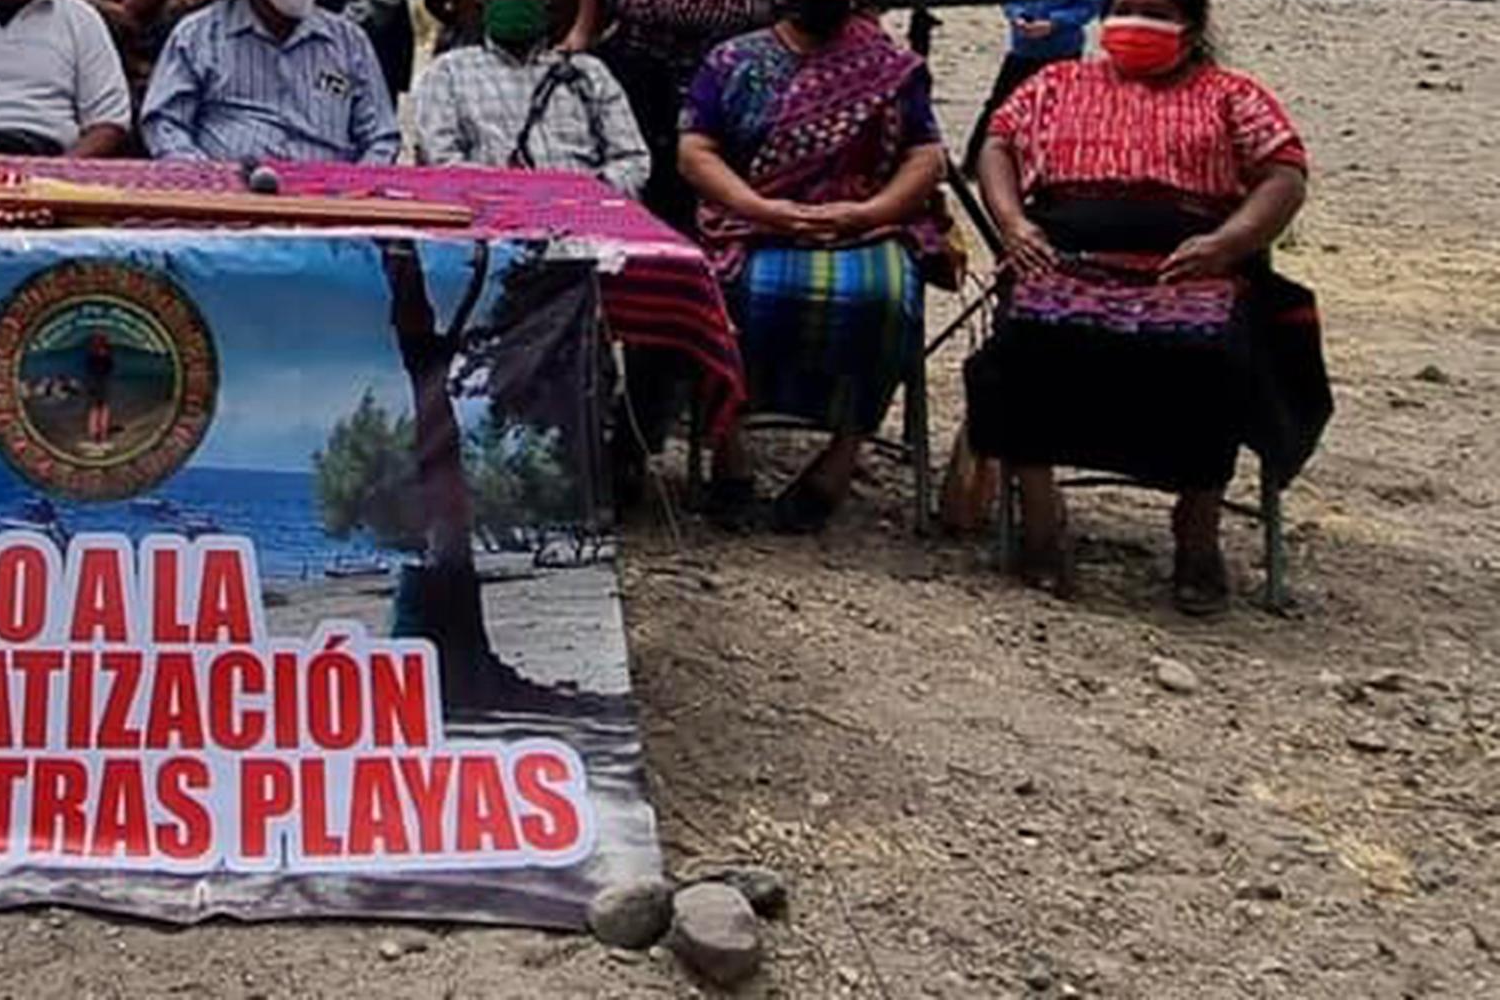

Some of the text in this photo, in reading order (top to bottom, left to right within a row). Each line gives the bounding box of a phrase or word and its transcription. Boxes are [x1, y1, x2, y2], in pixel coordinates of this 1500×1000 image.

[73, 547, 127, 643] A
[155, 548, 252, 644] LA
[240, 754, 581, 857] PLAYAS
